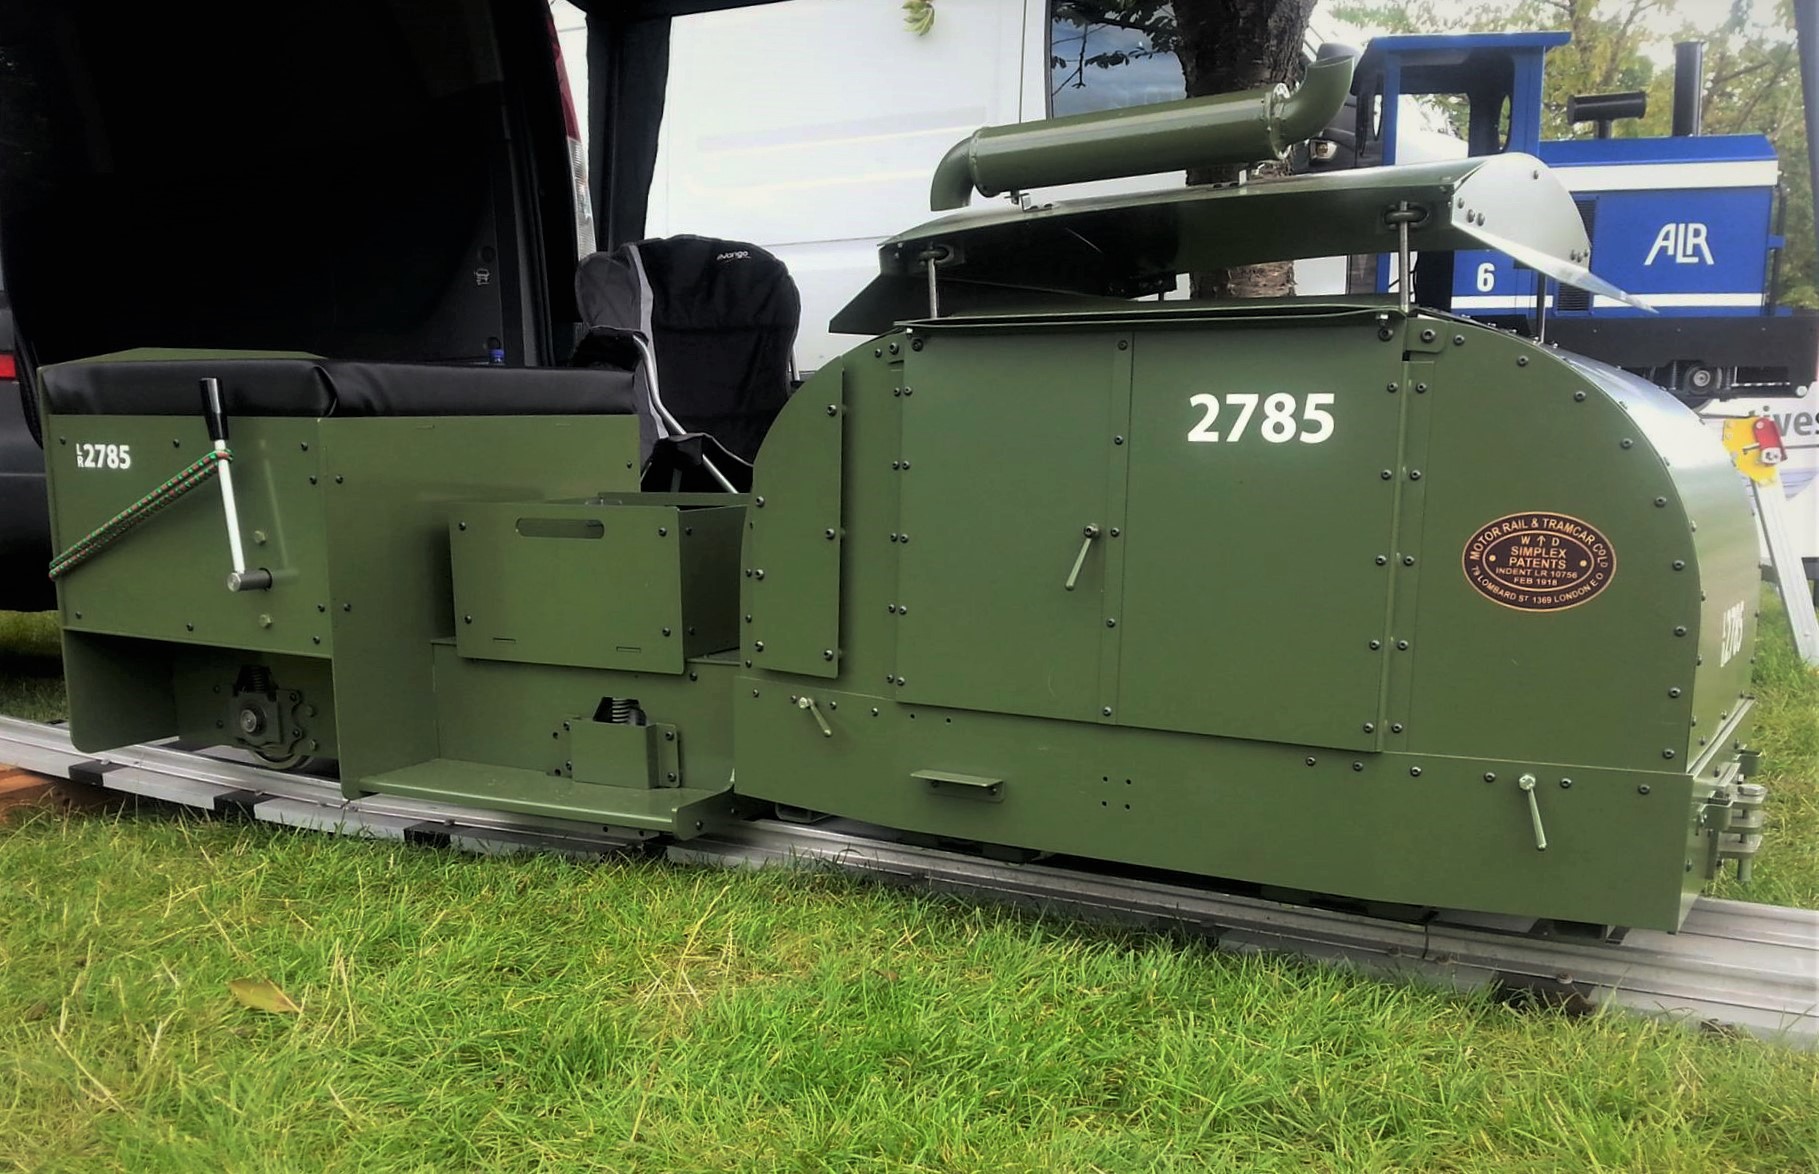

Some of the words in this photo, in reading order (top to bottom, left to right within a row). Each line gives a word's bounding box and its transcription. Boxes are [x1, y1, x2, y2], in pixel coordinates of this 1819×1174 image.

[1643, 222, 1714, 266] ALR
[1476, 262, 1495, 292] 6
[1187, 392, 1335, 444] 2785
[83, 443, 131, 469] 2785
[1469, 526, 1502, 560] MOTOR
[1502, 519, 1528, 533] RAIL
[1531, 517, 1539, 528] &
[1543, 517, 1596, 545] TRAMCAR
[1521, 536, 1531, 545] W
[1551, 537, 1560, 547] D
[1509, 557, 1567, 569] PATENTS
[1510, 546, 1567, 559] SIMPLEX
[1495, 567, 1533, 576] INDENT
[1551, 571, 1578, 579] 10756
[1513, 577, 1533, 585] FEB
[1536, 578, 1558, 586] 1918
[1477, 574, 1517, 600] LOMBARD
[1532, 596, 1552, 604] 1369
[1553, 585, 1592, 603] LONDON
[1590, 579, 1598, 587] E
